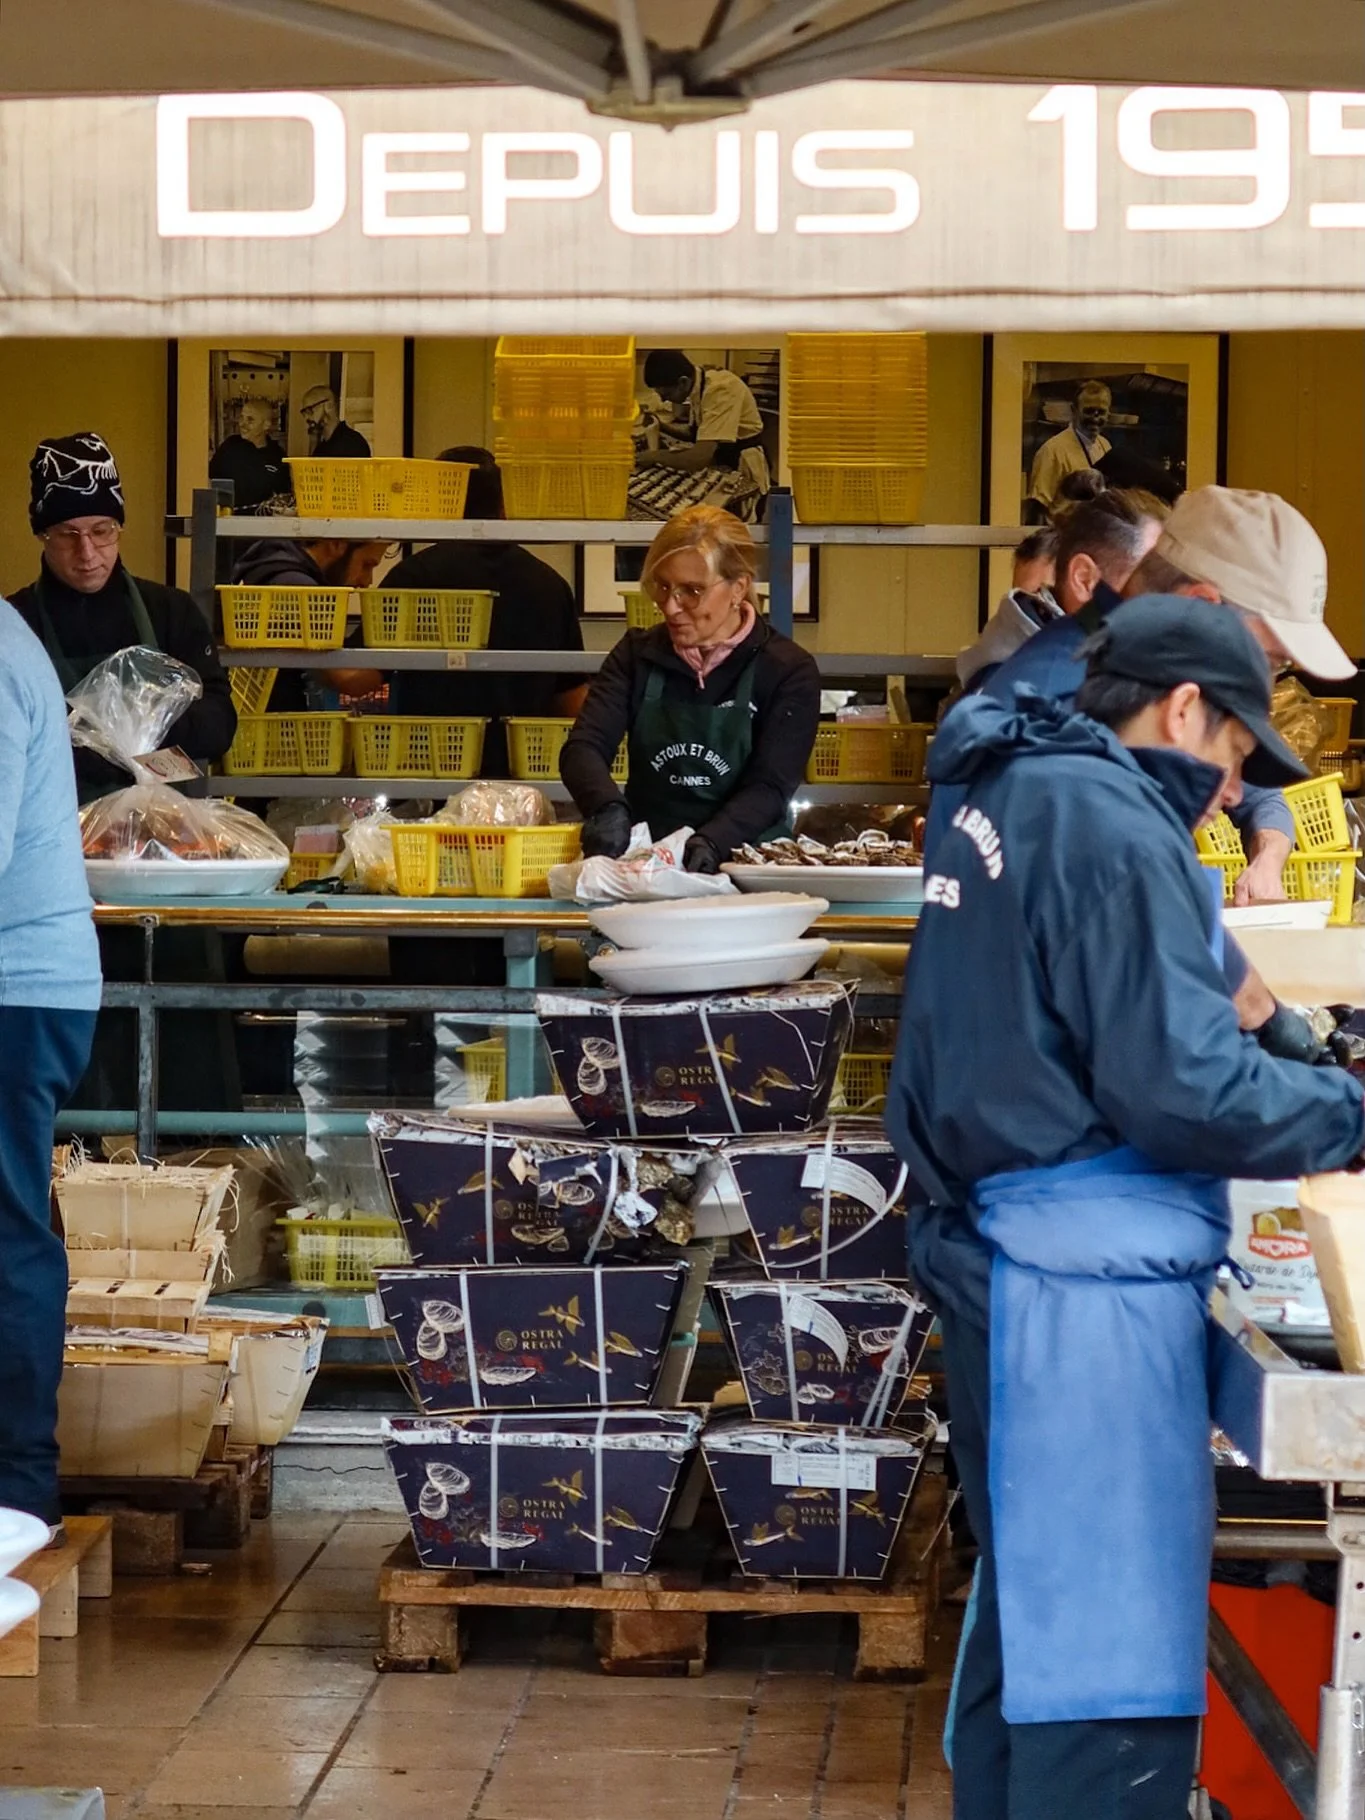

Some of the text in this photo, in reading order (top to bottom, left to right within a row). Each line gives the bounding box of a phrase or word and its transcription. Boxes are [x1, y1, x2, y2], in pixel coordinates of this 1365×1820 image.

[156, 91, 921, 238] DEPUIS
[650, 743, 731, 776] ASTOUX ET BRUN
[669, 775, 712, 786] CANNES
[679, 1067, 718, 1075] OSTR
[521, 1330, 563, 1340] OSTRA
[522, 1341, 564, 1350] REGAL
[523, 1500, 566, 1509] OSTRA
[524, 1510, 564, 1519] REGAL
[800, 1506, 841, 1516] OSTR
